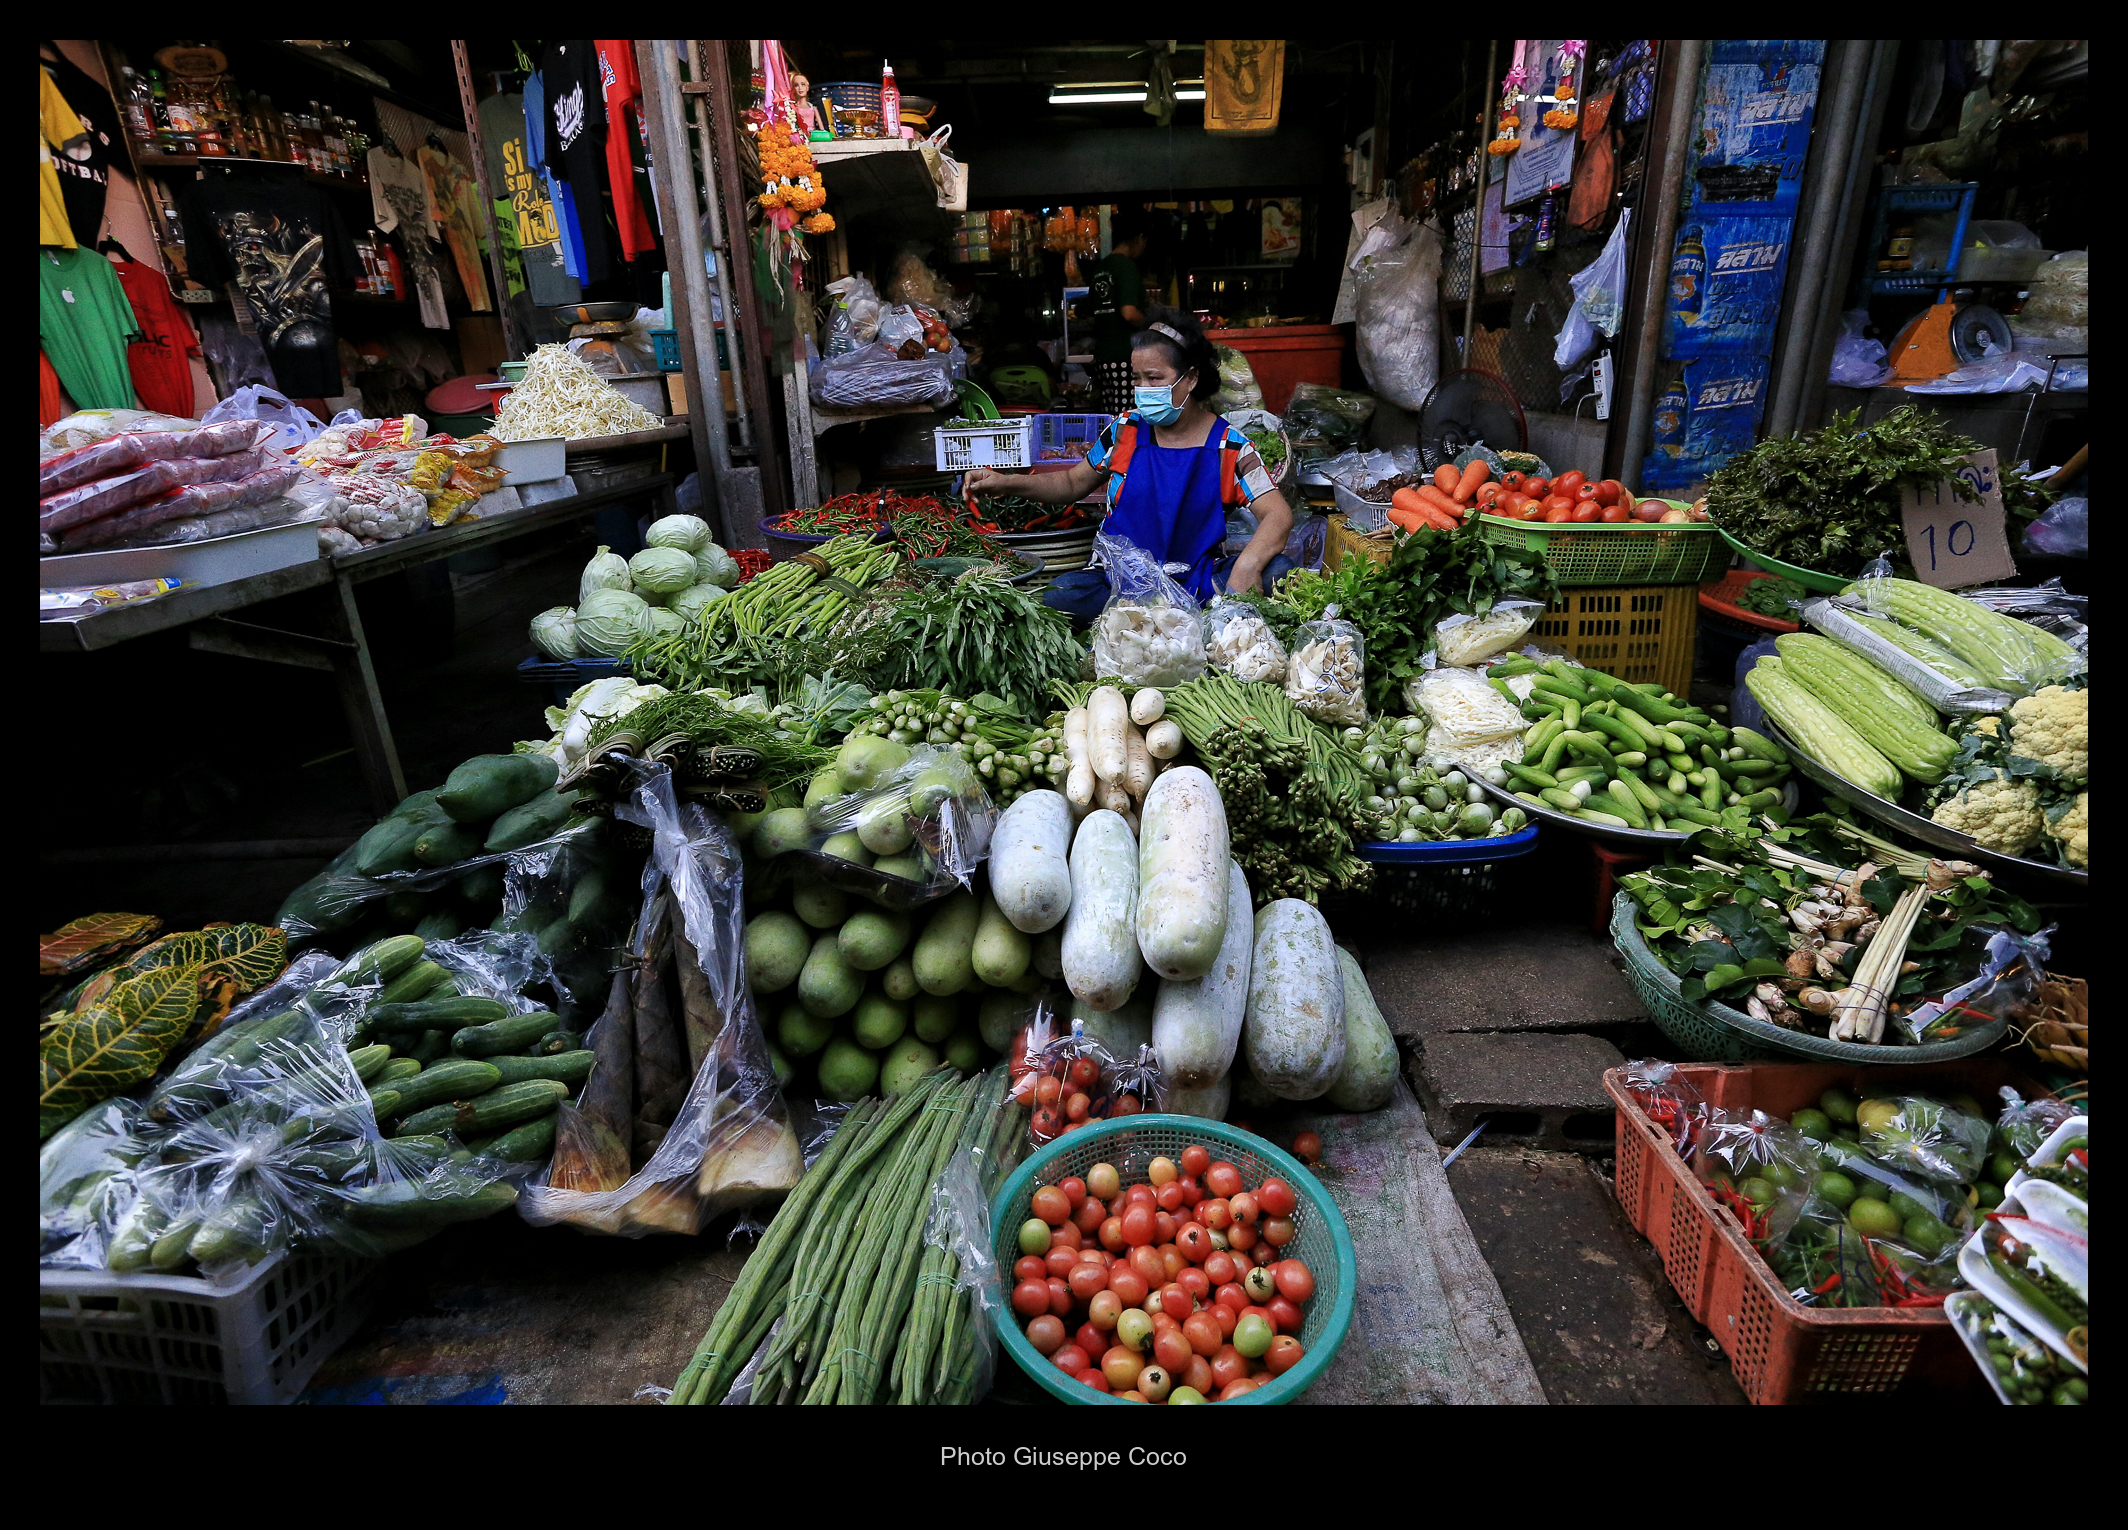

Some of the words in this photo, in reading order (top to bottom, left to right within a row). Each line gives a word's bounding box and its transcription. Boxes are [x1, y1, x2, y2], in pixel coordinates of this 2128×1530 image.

[502, 137, 525, 176] Si
[504, 174, 516, 192] is
[516, 172, 533, 191] my
[512, 189, 545, 213] Role
[1920, 520, 1975, 571] 10
